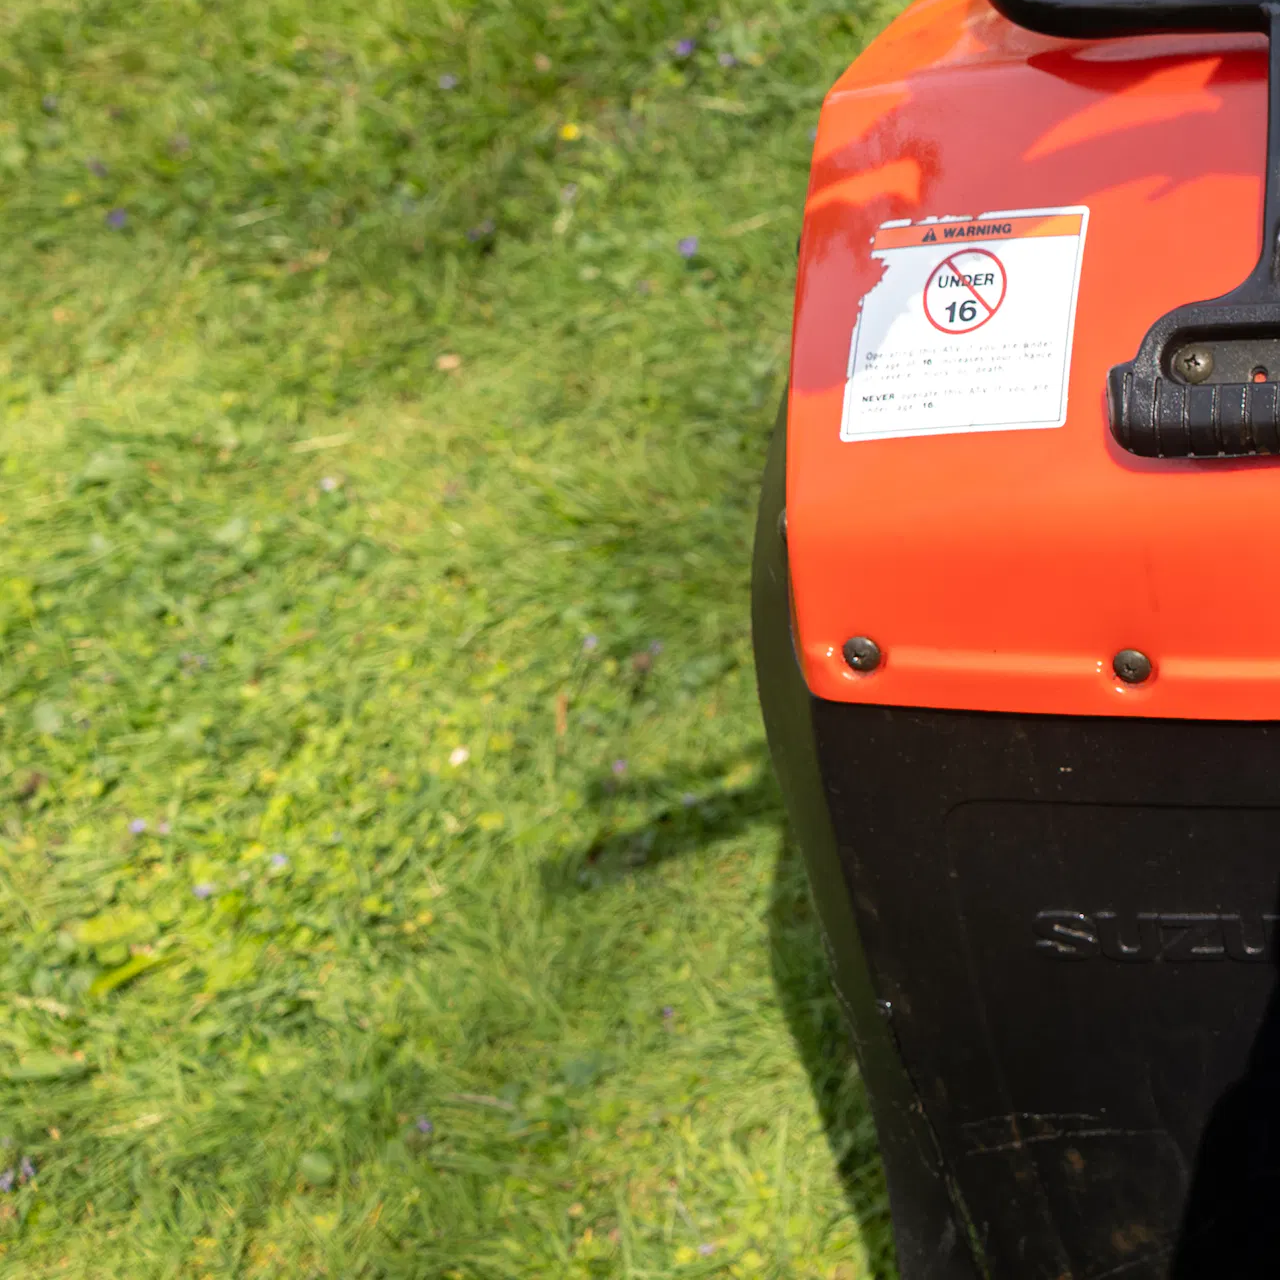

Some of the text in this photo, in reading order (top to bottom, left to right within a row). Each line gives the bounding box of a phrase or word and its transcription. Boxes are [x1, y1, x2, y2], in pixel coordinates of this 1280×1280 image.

[943, 223, 1013, 238] WARNING
[937, 272, 995, 289] UNDER
[944, 299, 977, 323] 16
[861, 393, 896, 403] NEVER
